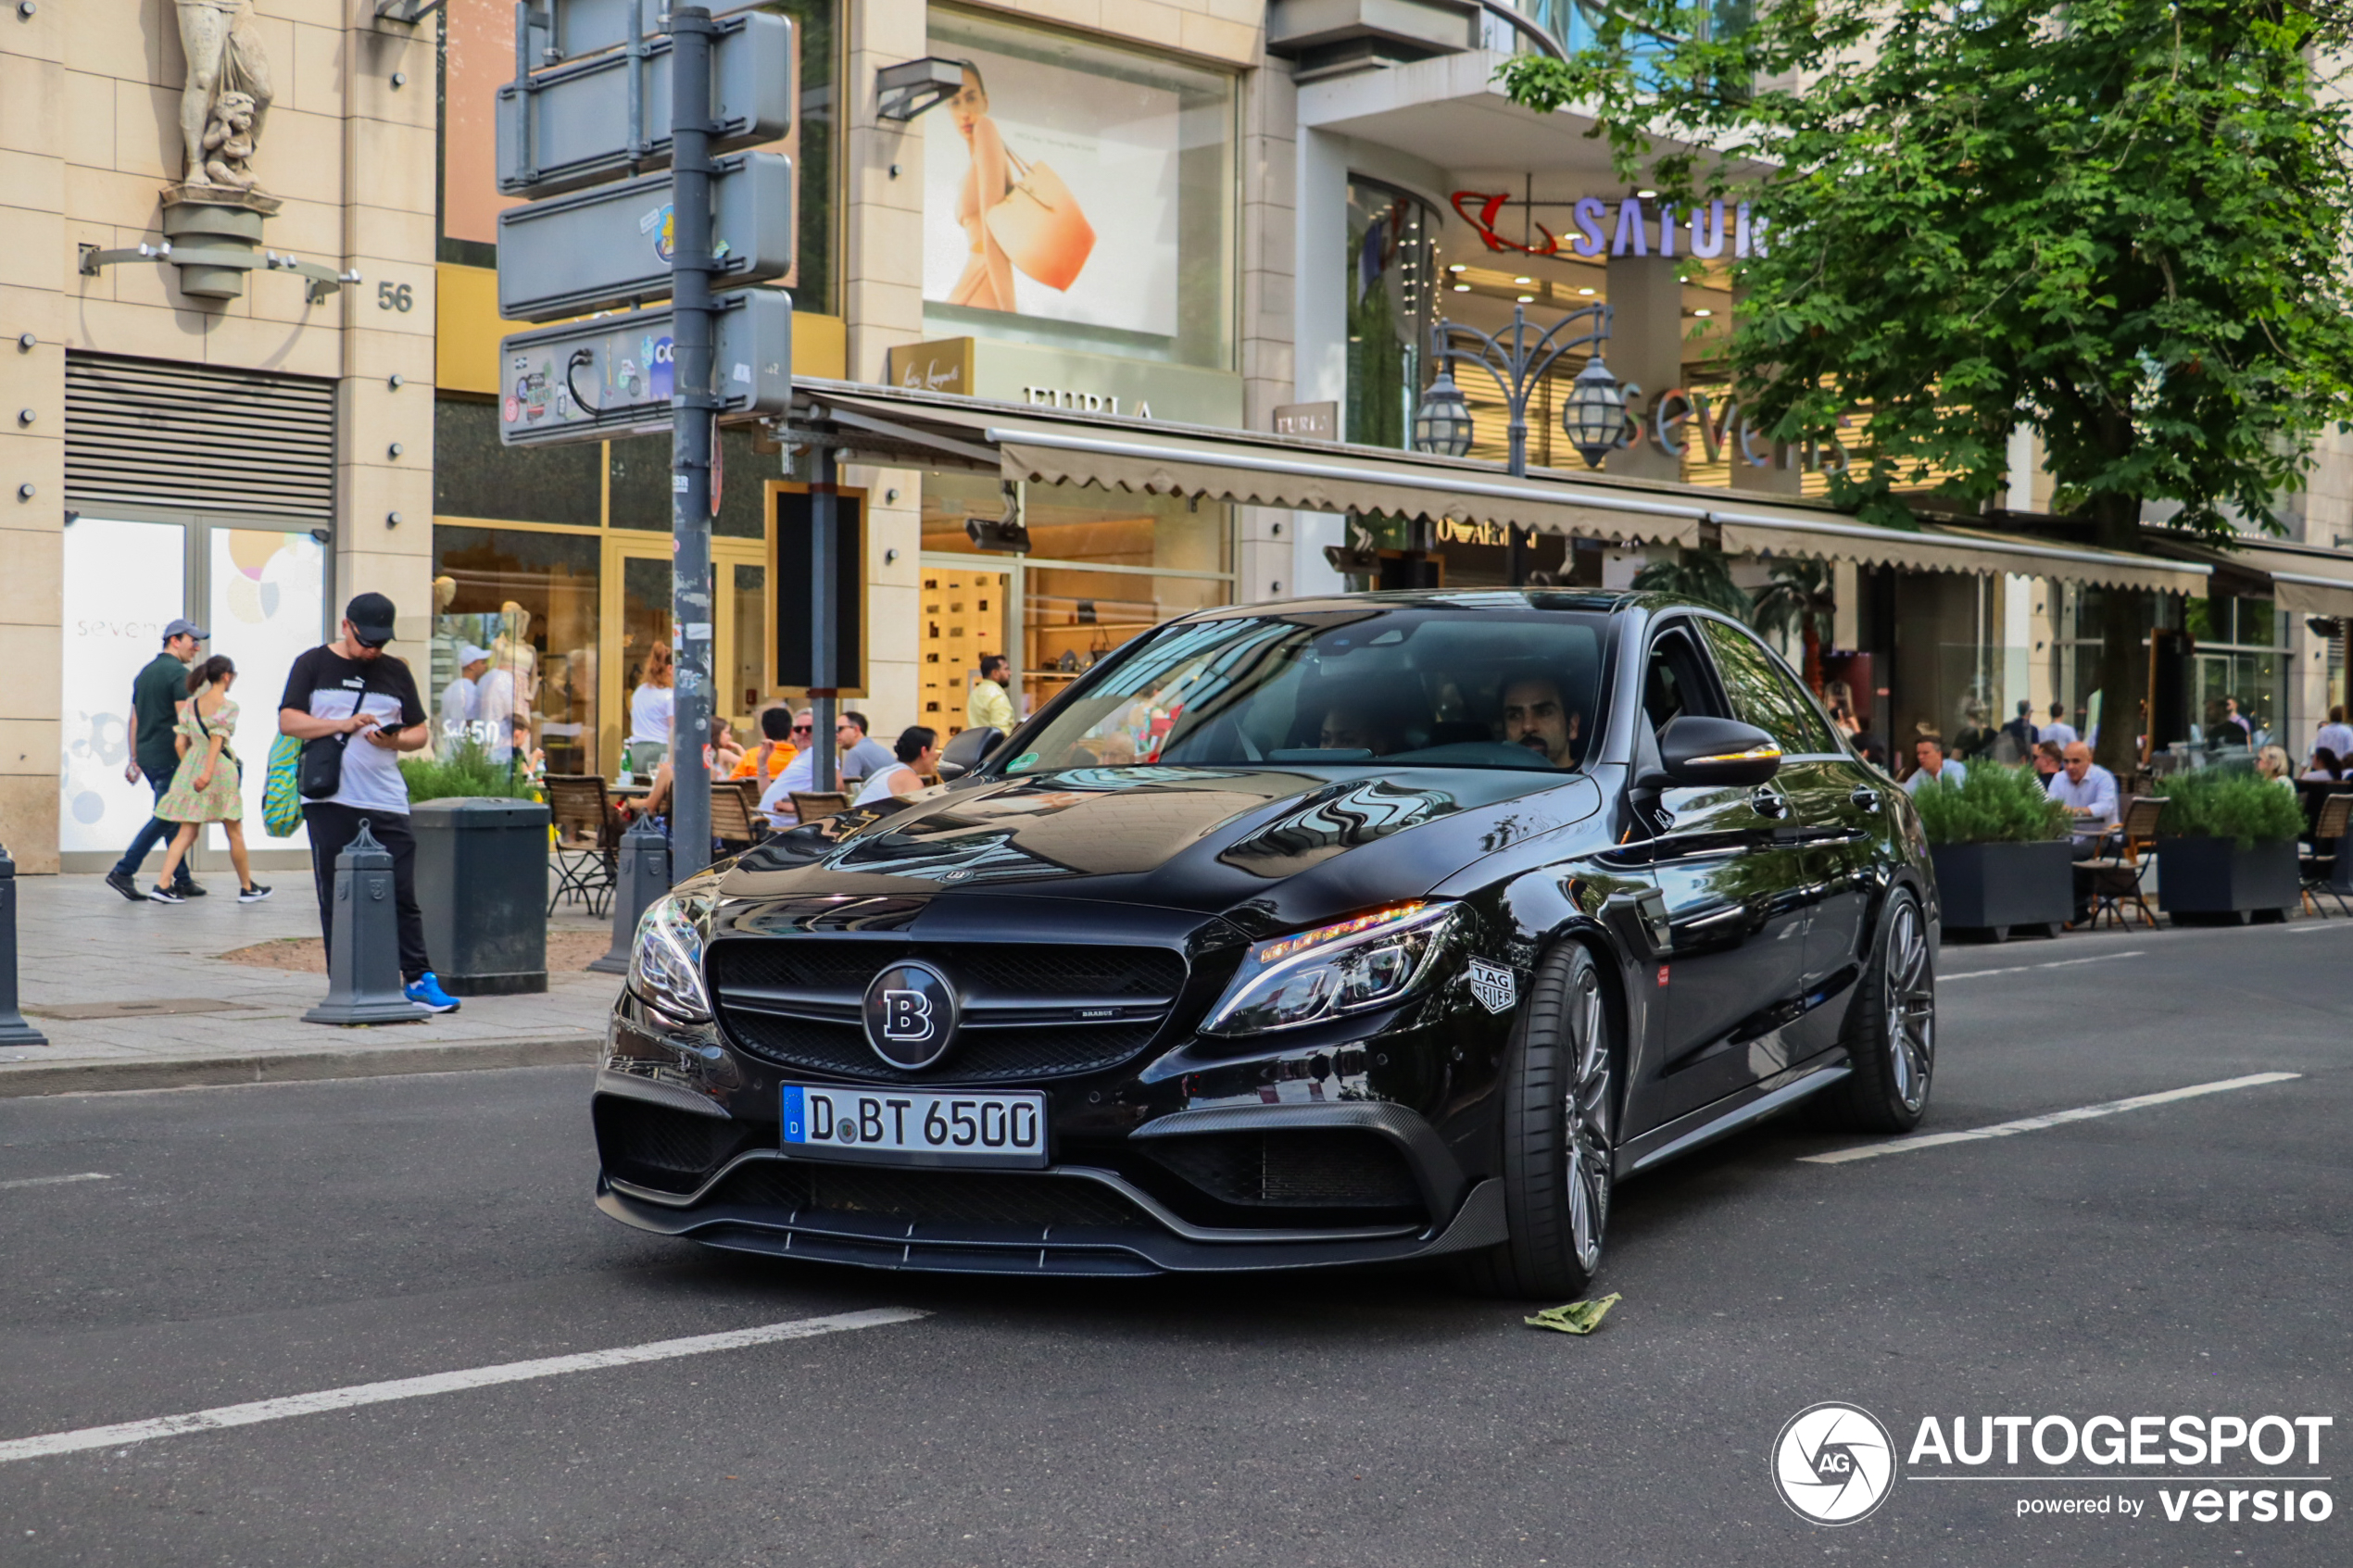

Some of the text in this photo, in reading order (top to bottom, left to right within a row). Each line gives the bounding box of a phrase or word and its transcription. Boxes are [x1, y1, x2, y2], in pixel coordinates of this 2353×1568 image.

[1573, 196, 1775, 259] SATUR
[378, 281, 413, 313] 56
[78, 619, 166, 639] seven
[472, 720, 500, 745] 50
[1475, 967, 1509, 988] TAG
[1475, 984, 1510, 1008] HEUER
[884, 989, 935, 1041] B
[789, 1122, 799, 1135] D
[811, 1094, 1037, 1148] D BT 6500
